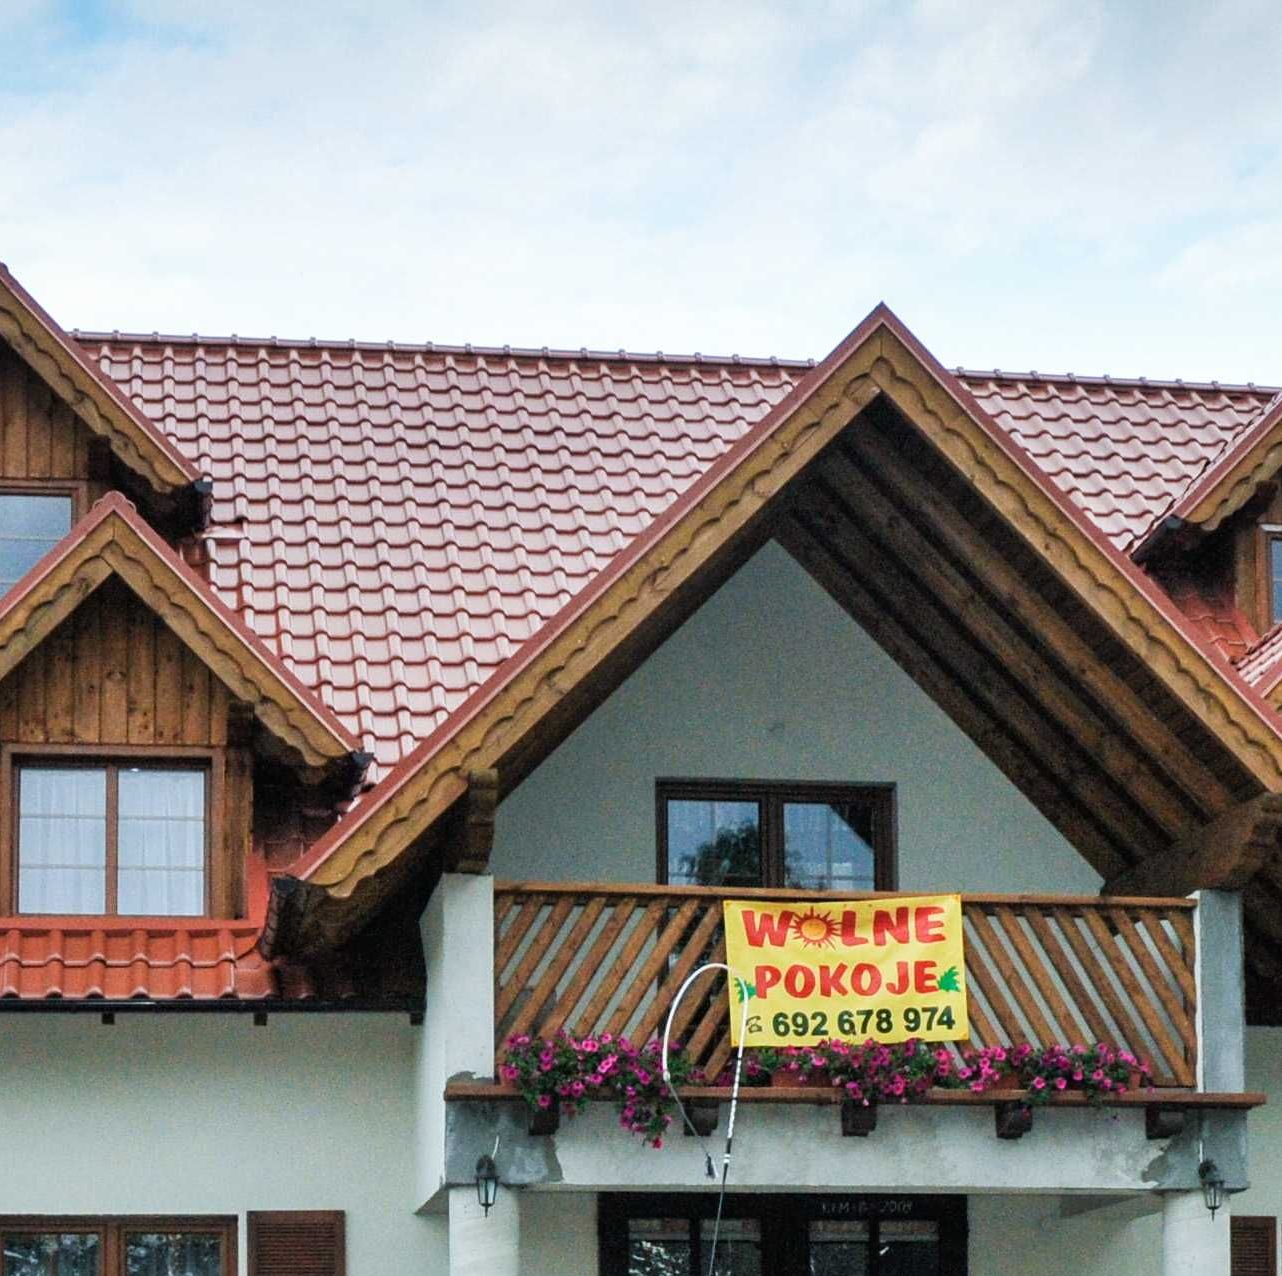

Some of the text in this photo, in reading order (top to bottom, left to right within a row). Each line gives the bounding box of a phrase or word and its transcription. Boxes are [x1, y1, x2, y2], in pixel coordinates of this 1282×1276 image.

[741, 906, 946, 949] WOLNE
[754, 960, 940, 1000] POKOJE
[772, 1005, 956, 1037] 692 678 974
